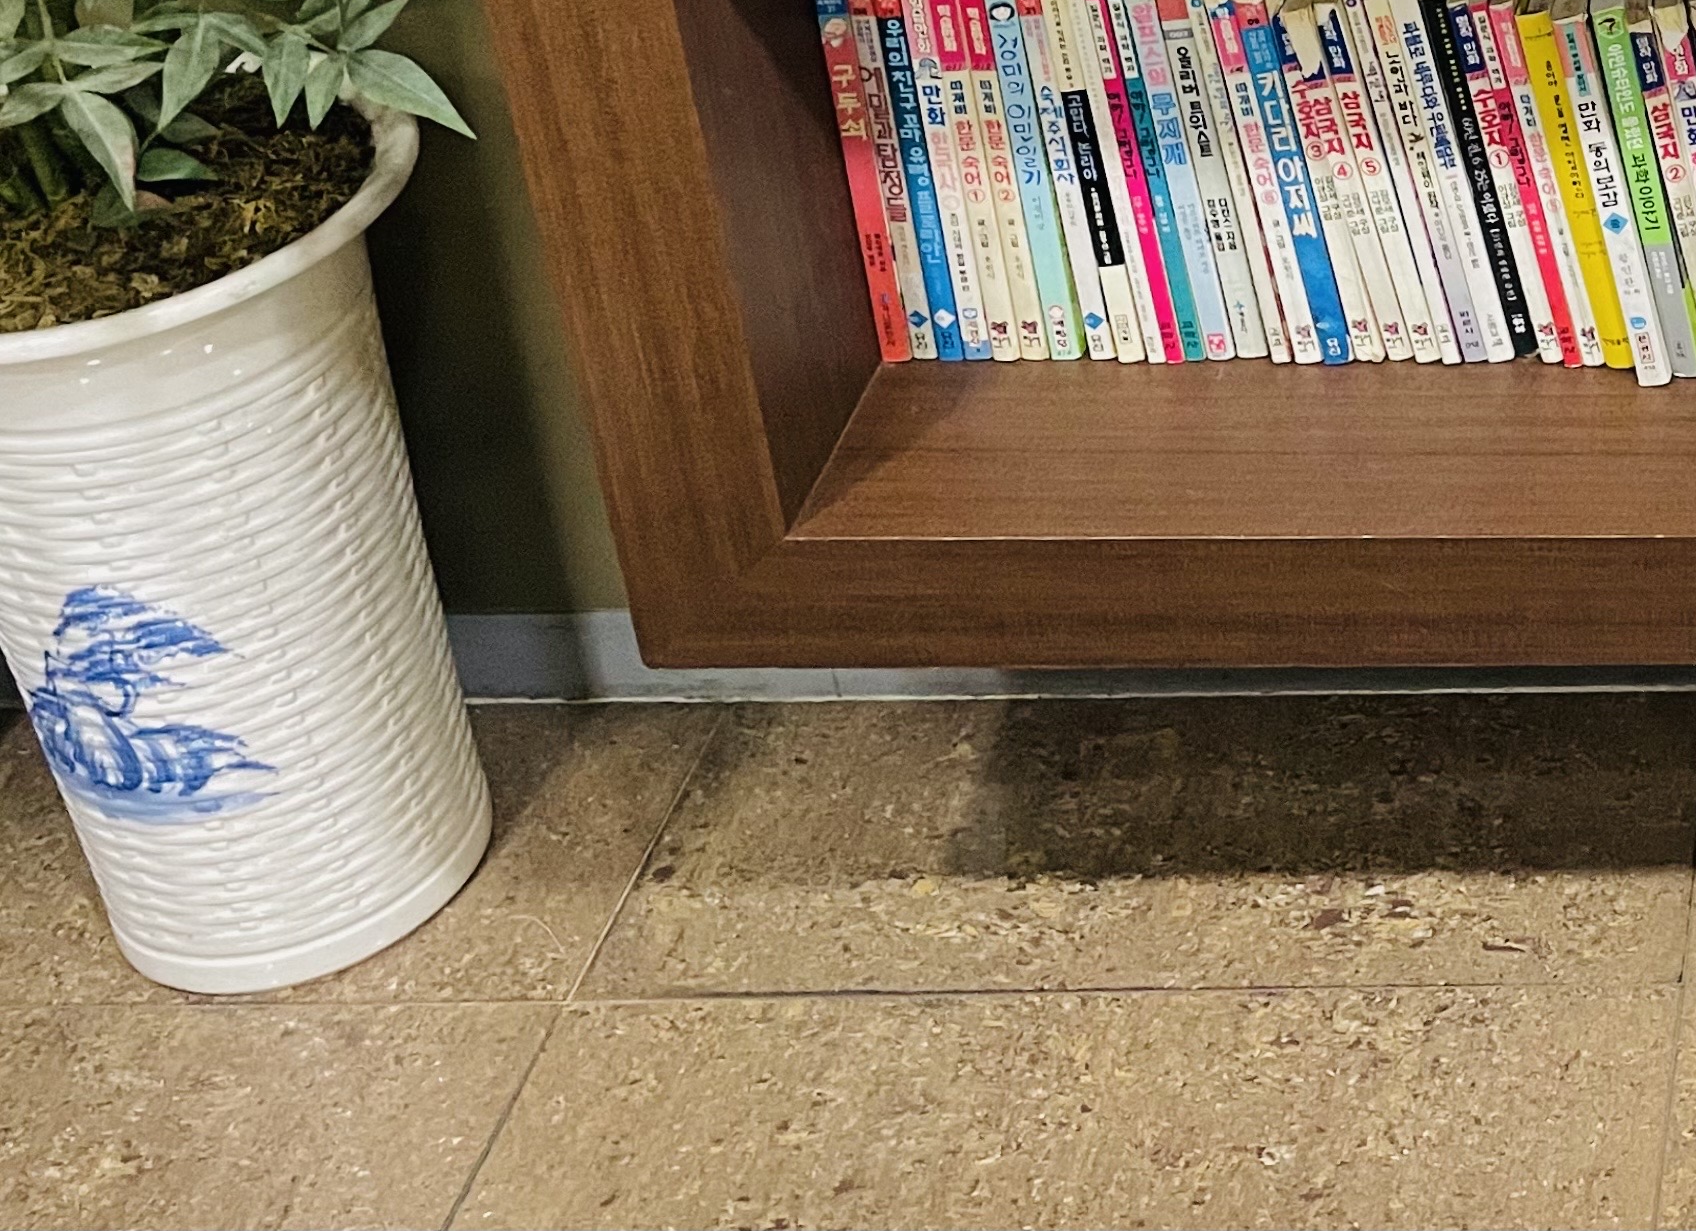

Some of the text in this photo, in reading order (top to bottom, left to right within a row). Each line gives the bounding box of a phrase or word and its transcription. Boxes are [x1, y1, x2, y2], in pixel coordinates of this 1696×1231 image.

[1152, 93, 1187, 165] 무지개
[1314, 96, 1345, 156] 삼국지
[1342, 91, 1374, 151] 삼국지
[1650, 104, 1681, 160] 삼국지
[1256, 70, 1317, 239] 키다리 아저씨
